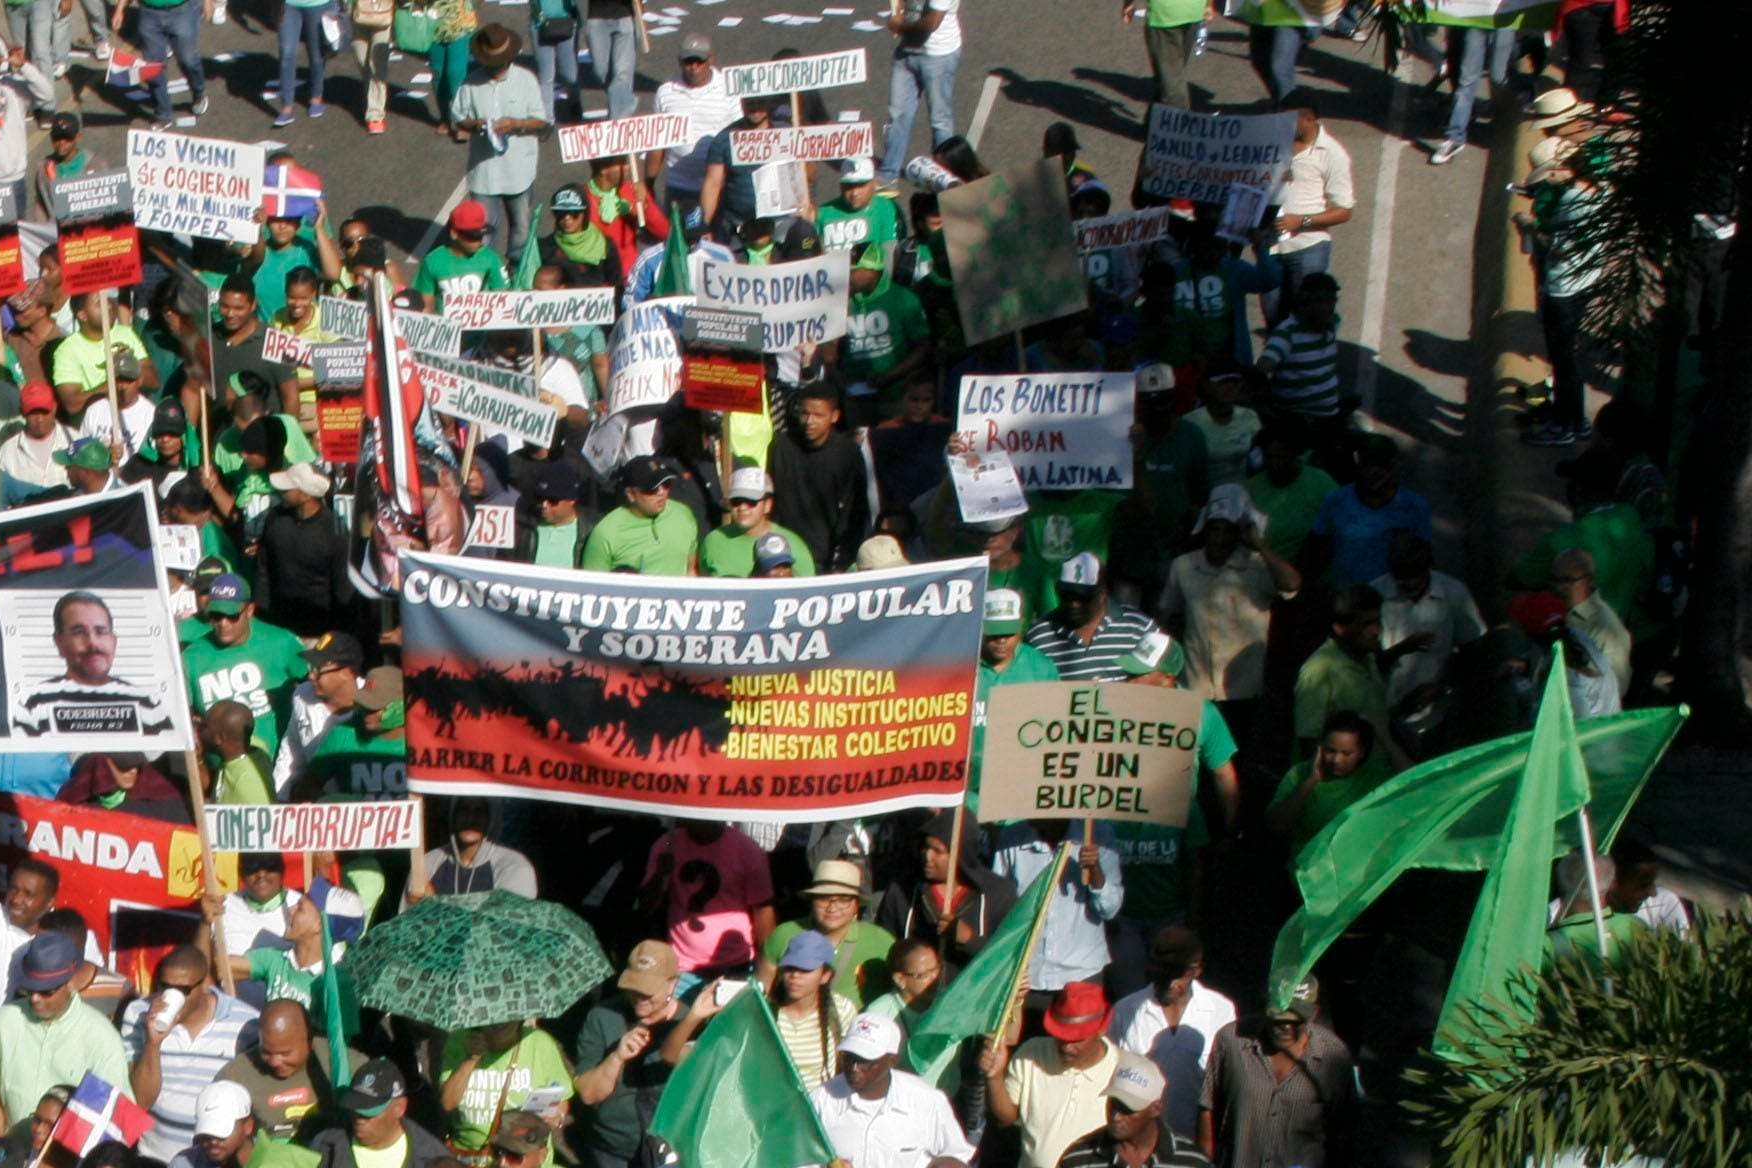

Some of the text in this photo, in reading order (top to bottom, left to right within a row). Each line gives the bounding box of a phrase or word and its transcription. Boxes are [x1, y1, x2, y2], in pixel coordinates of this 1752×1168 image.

[131, 133, 236, 169] LOS VICINI
[56, 172, 128, 194] CONSTITUYENTE
[67, 186, 110, 203] POPULAR
[163, 165, 250, 201] COGIERON
[1150, 176, 1230, 202] ODEBRE
[148, 208, 234, 240] FONPER
[202, 195, 253, 221] MILLONE
[823, 217, 867, 246] NO
[703, 262, 835, 307] EXPROPIAR
[962, 378, 1006, 416] LOS
[1045, 461, 1124, 487] LATINA
[402, 568, 975, 632] CONSTITUYENTE POPULAR
[561, 624, 831, 666] Y SOBERANA
[198, 661, 262, 704] NO
[804, 668, 897, 697] JUSTICIA
[56, 707, 134, 721] ODEBRECHT
[814, 691, 969, 729] INSTITUCIONES
[1069, 689, 1109, 716] EL
[845, 721, 957, 758] COLECTIVO
[1017, 719, 1197, 751] CONGRESO
[407, 745, 967, 797] BARRER LA CORRUPCION Y LAS DESIGUALDADES
[1043, 751, 1140, 779] ES UN
[1035, 784, 1150, 814] BURDEL
